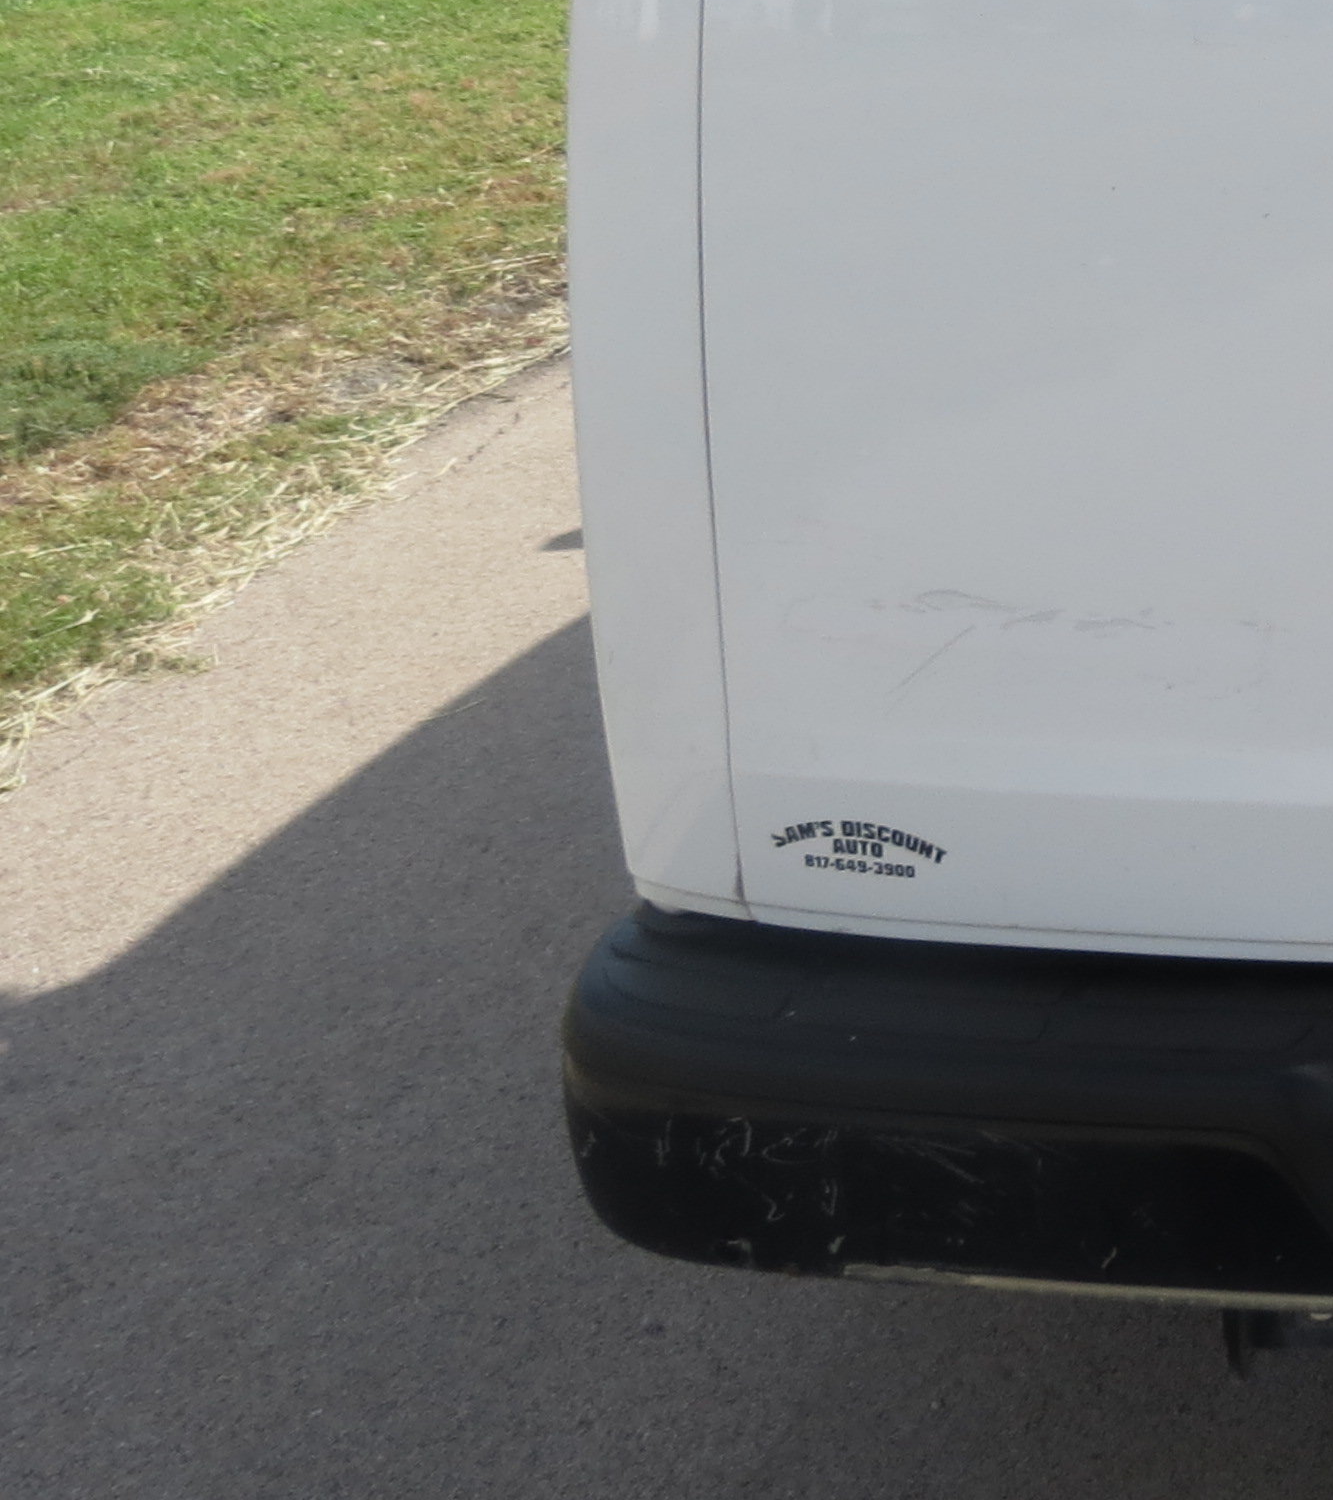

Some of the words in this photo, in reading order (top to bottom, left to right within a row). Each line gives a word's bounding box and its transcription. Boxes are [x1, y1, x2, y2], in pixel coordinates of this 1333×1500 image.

[832, 837, 884, 859] AUTO
[840, 820, 948, 864] DISCOUNT
[803, 853, 916, 879] 817-649-3900
